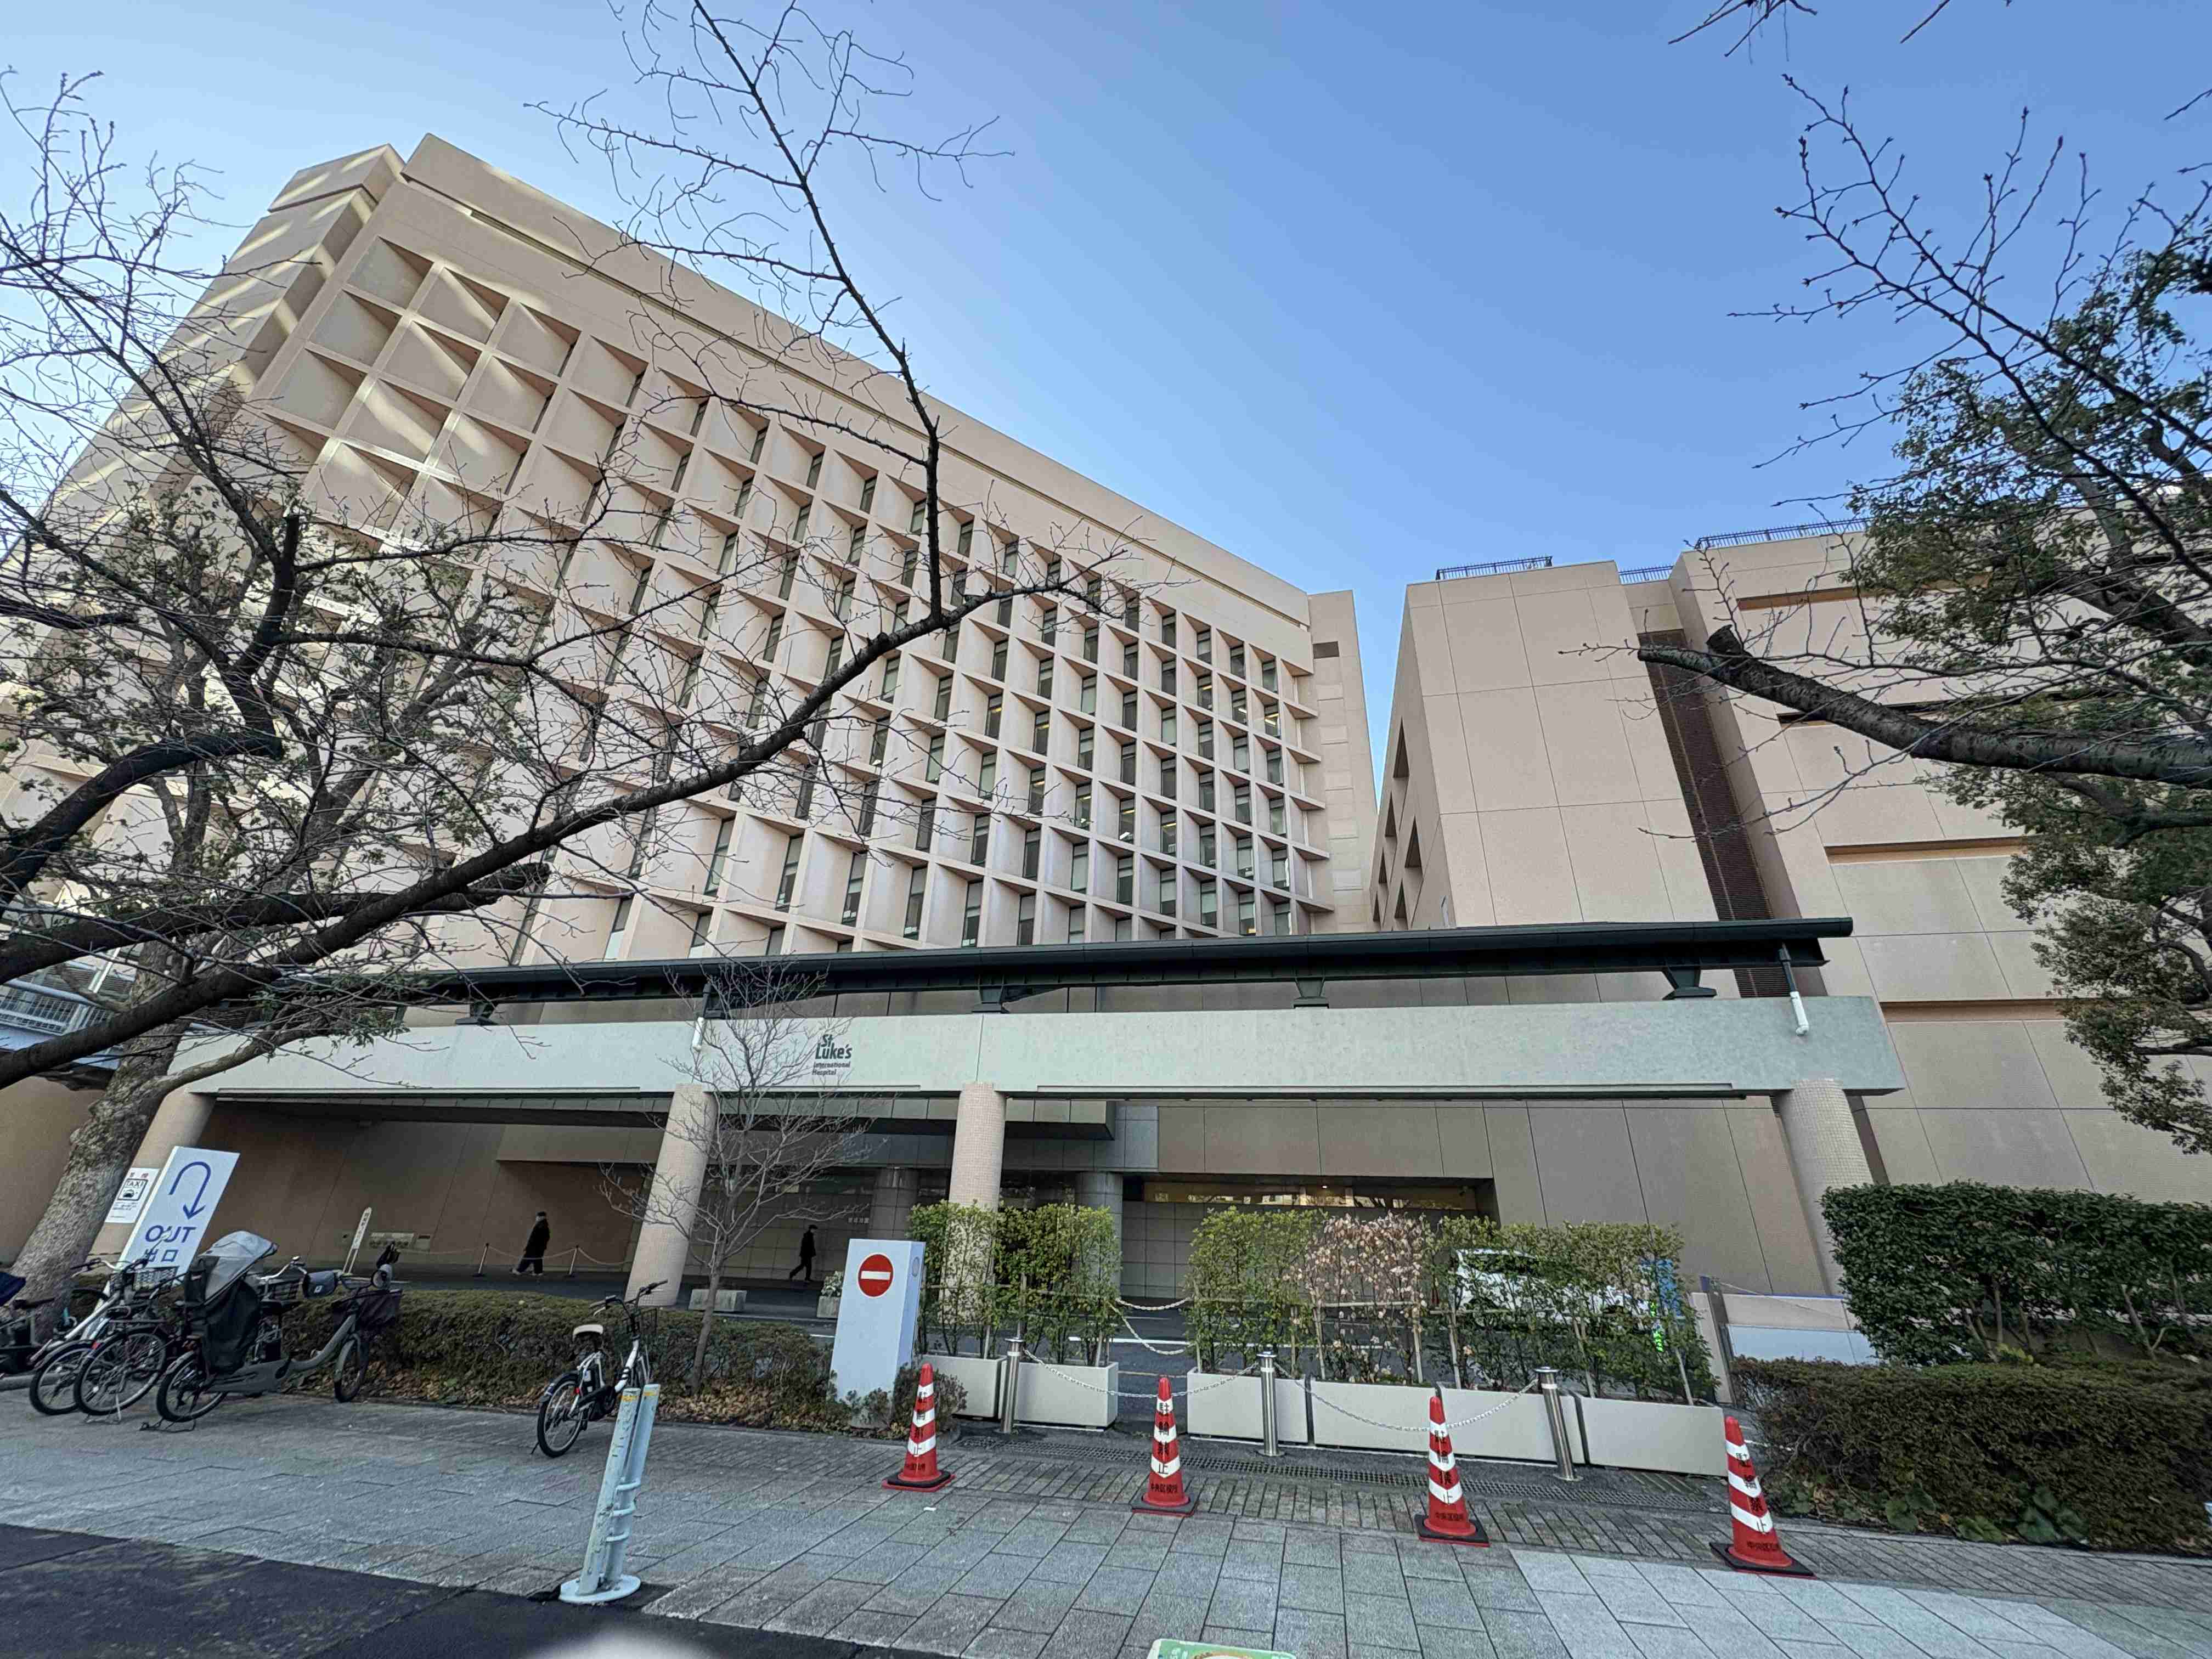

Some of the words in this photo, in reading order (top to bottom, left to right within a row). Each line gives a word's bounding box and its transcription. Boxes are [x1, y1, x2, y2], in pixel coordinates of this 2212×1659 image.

[821, 1034, 834, 1047] St
[815, 1042, 852, 1059] Luke's
[145, 1224, 197, 1243] OUT
